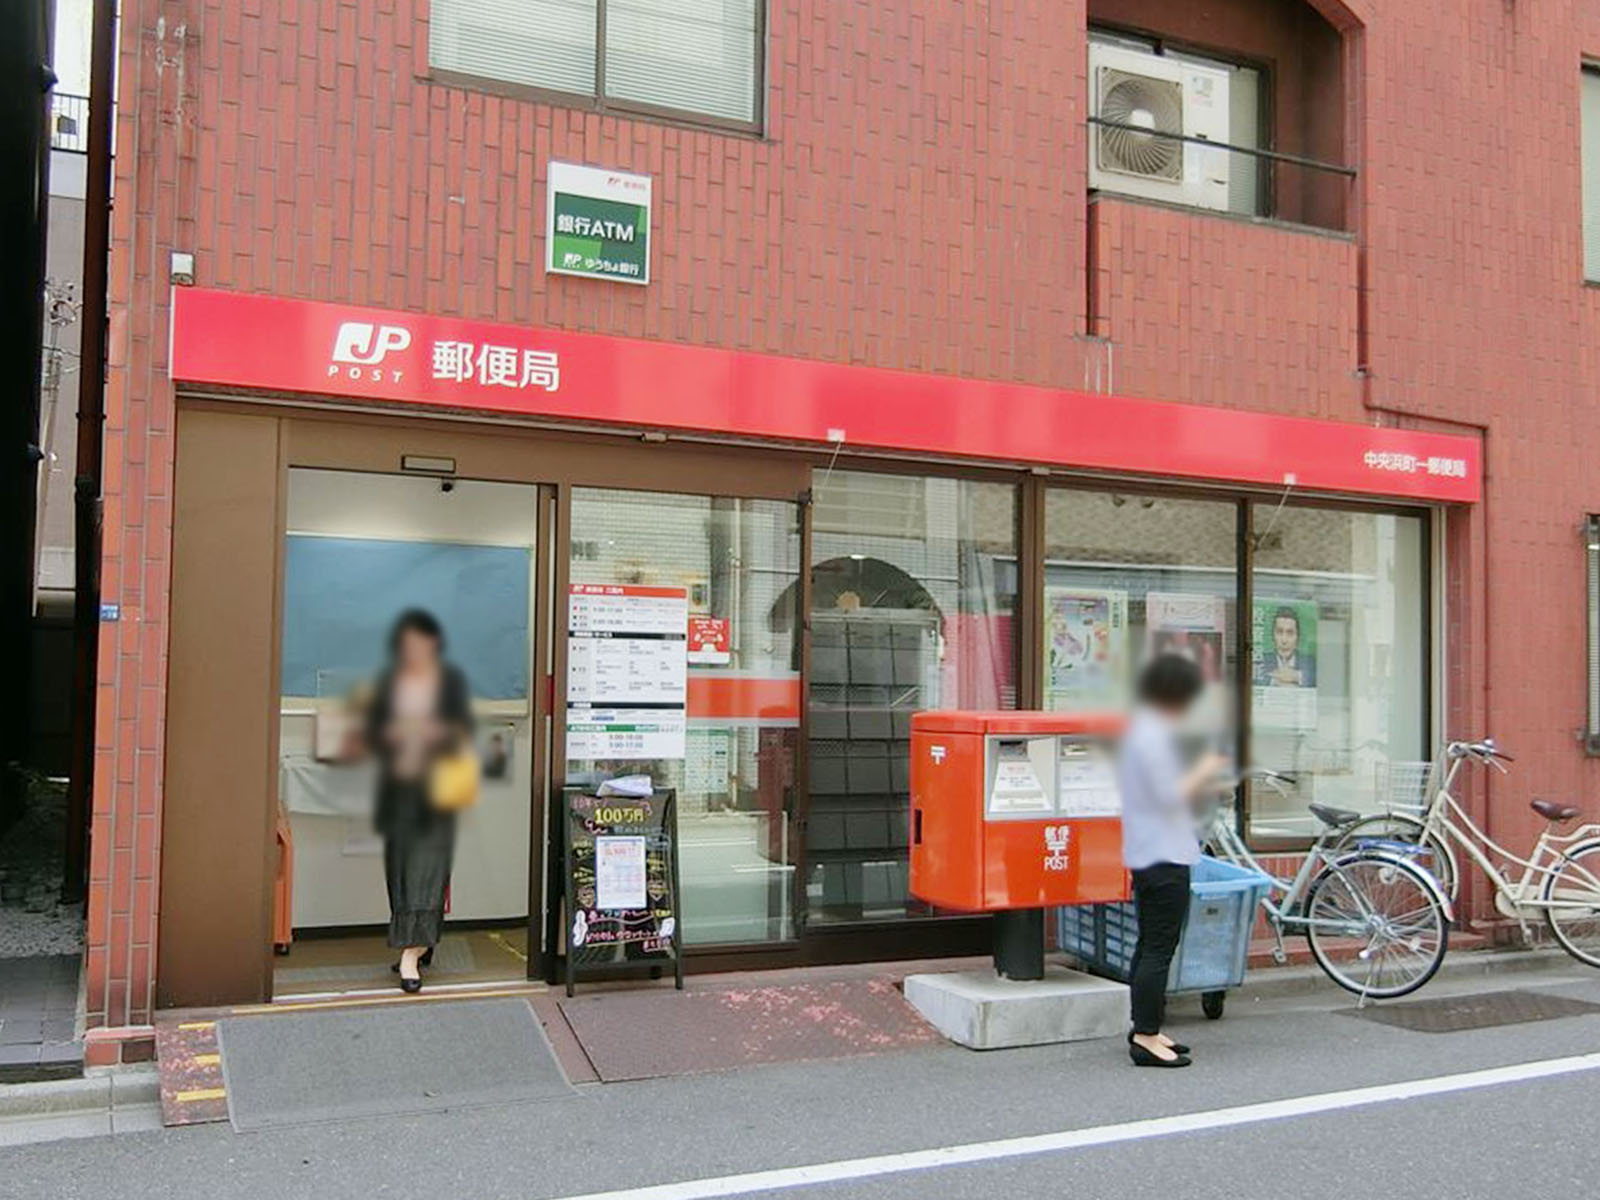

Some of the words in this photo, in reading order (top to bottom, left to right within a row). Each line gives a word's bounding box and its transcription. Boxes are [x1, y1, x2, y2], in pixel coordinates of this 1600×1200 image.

[557, 214, 634, 242] 銀行ATM
[327, 365, 404, 384] POST
[432, 341, 560, 392] 郵便局
[595, 807, 644, 824] 100万円
[1044, 855, 1068, 871] POST
